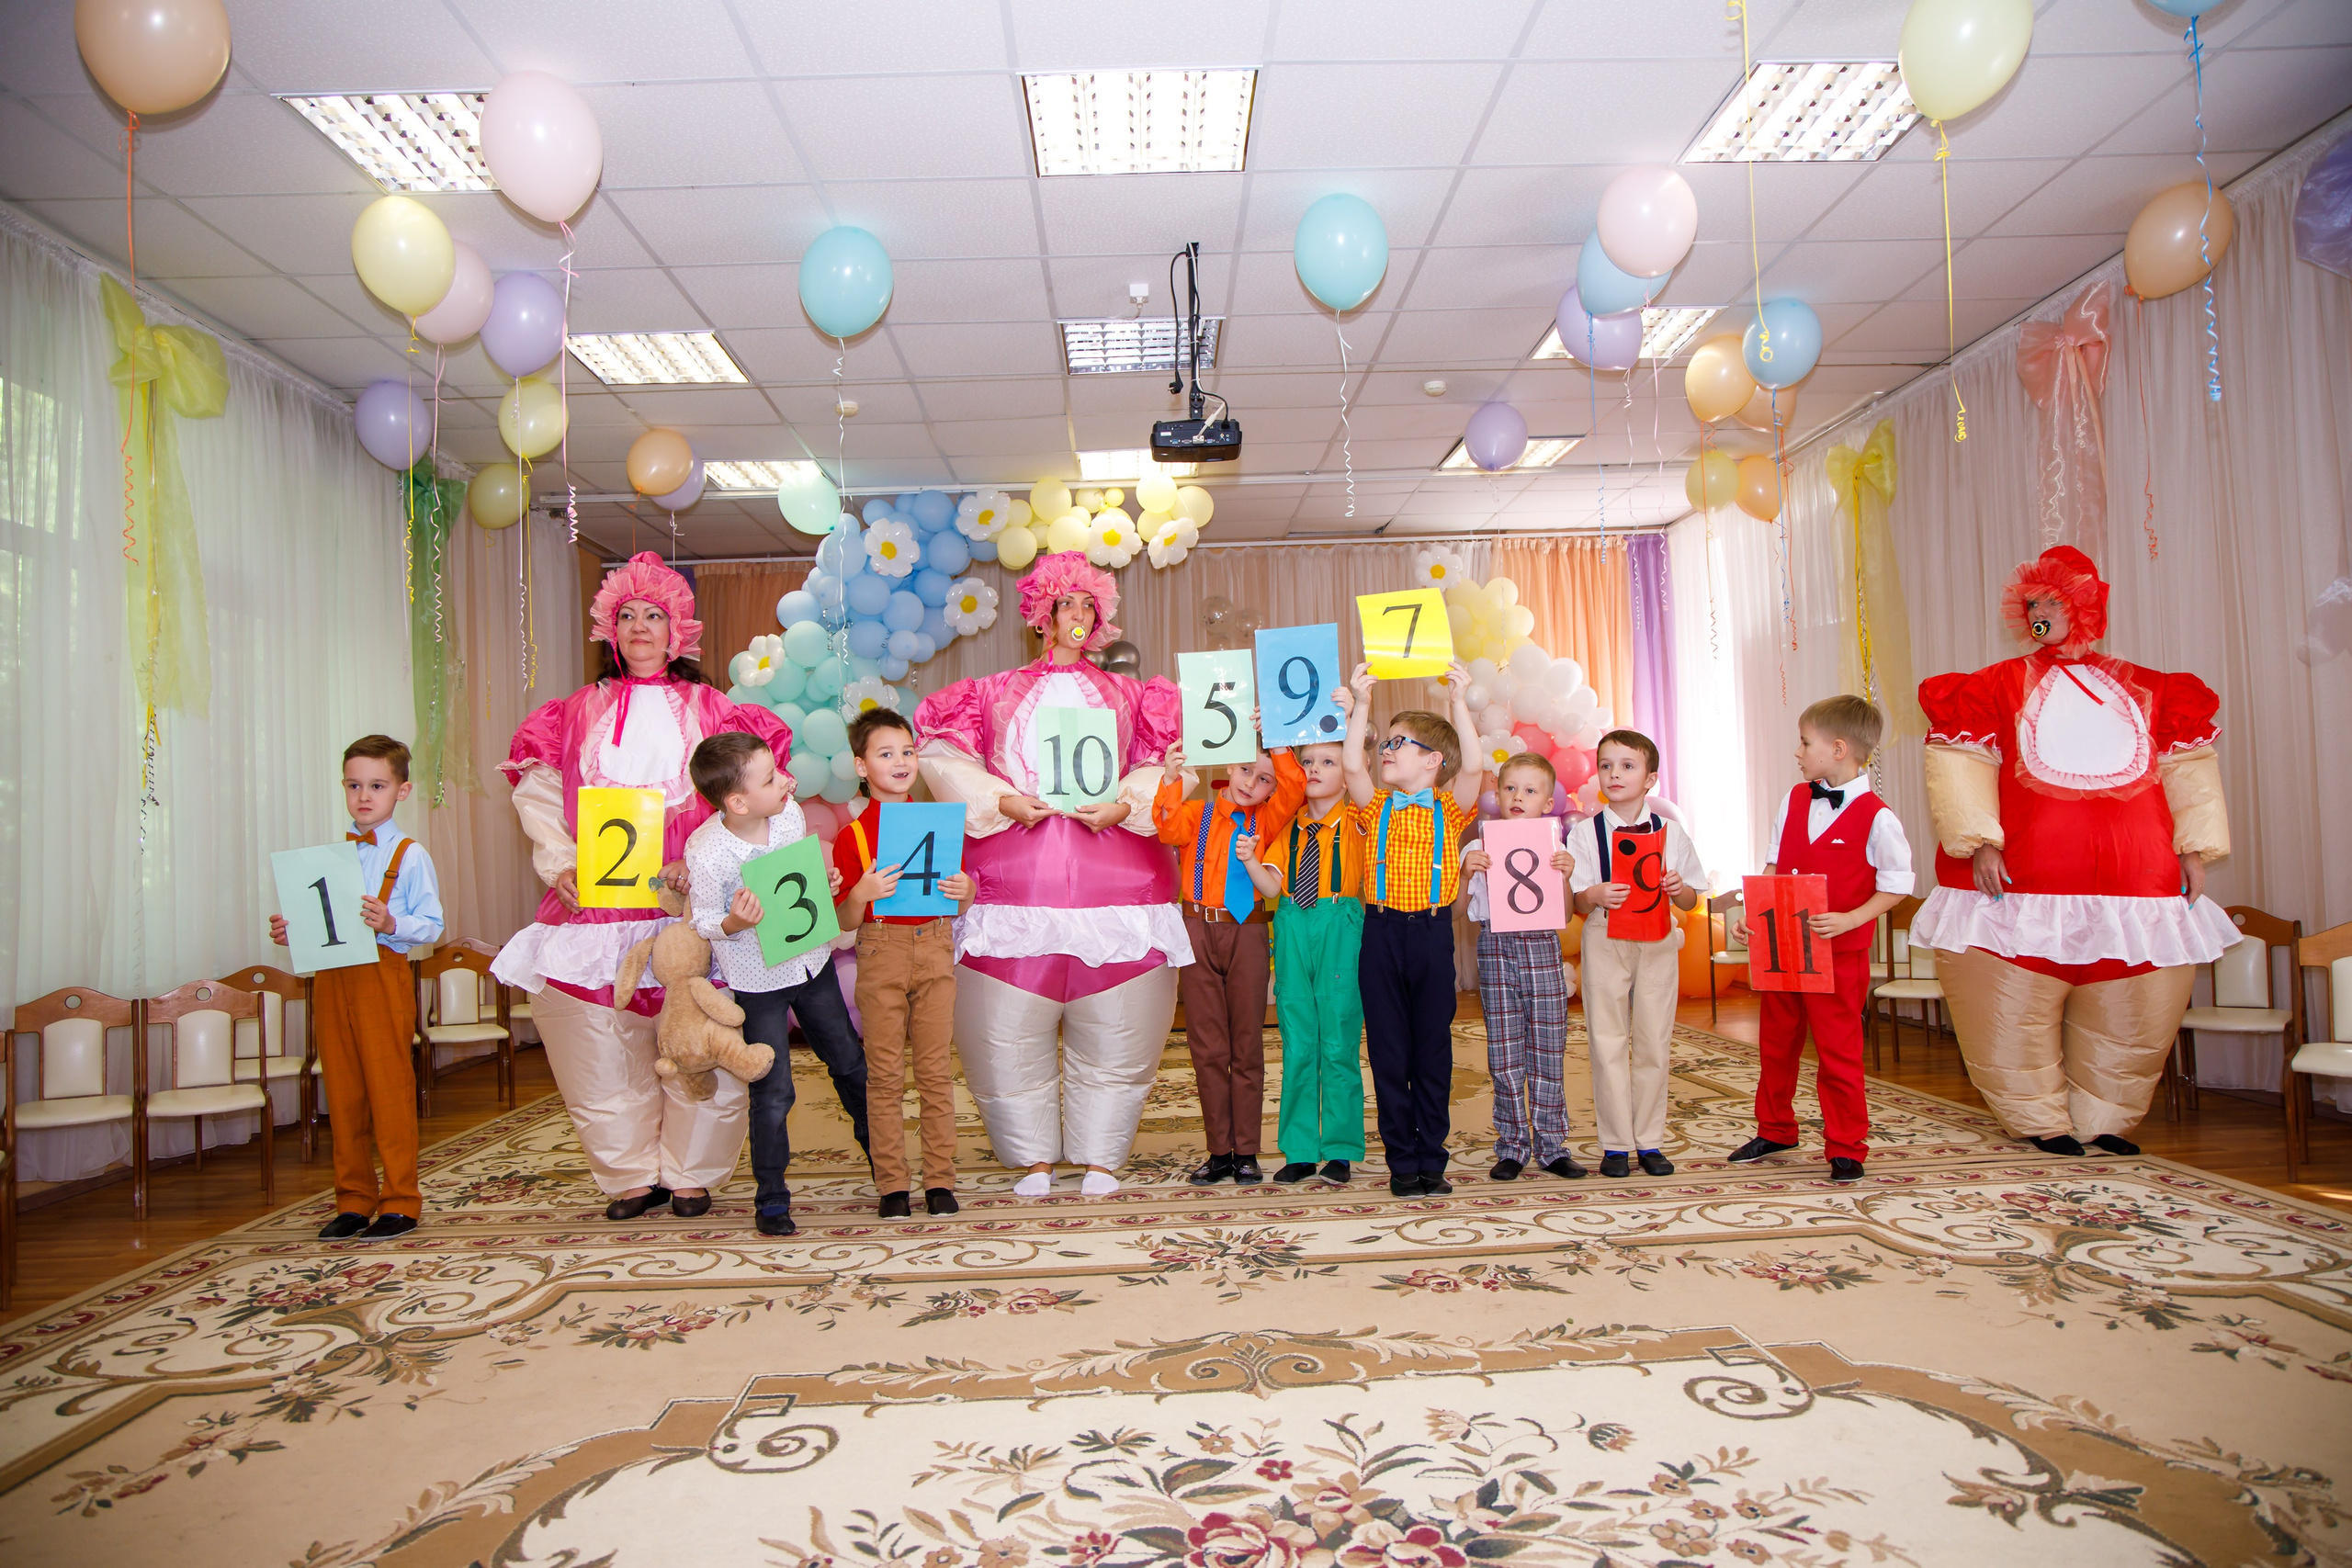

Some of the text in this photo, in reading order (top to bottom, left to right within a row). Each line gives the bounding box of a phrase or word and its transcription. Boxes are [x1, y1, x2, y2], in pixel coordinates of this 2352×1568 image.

[1382, 603, 1423, 659] 7
[1202, 682, 1238, 750] 5
[1044, 734, 1114, 797] 10
[594, 818, 640, 887] 2
[897, 830, 941, 897] 4
[1505, 848, 1544, 915] 8
[308, 876, 347, 948] 1
[774, 872, 819, 943] 3
[1757, 907, 1823, 975] 11
